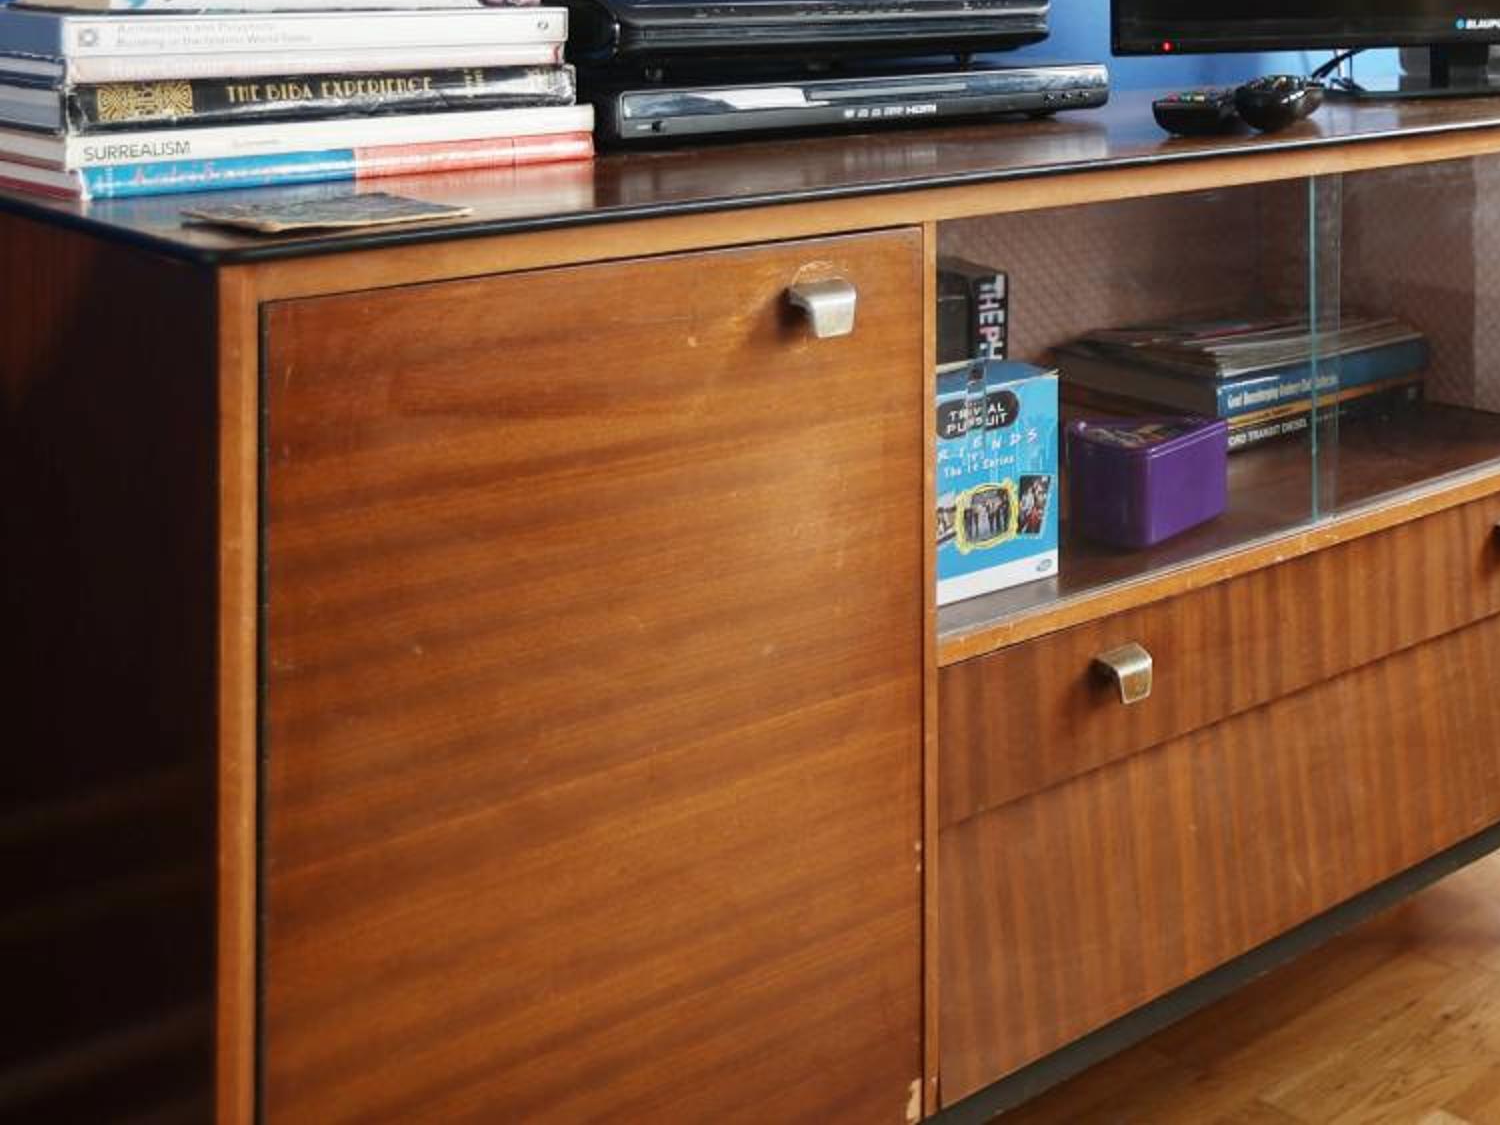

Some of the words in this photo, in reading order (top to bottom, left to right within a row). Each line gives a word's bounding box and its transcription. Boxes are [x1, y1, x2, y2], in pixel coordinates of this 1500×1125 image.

[225, 85, 260, 103] THE
[320, 76, 433, 98] EXPERIENCE
[84, 140, 191, 162] SURREALISM
